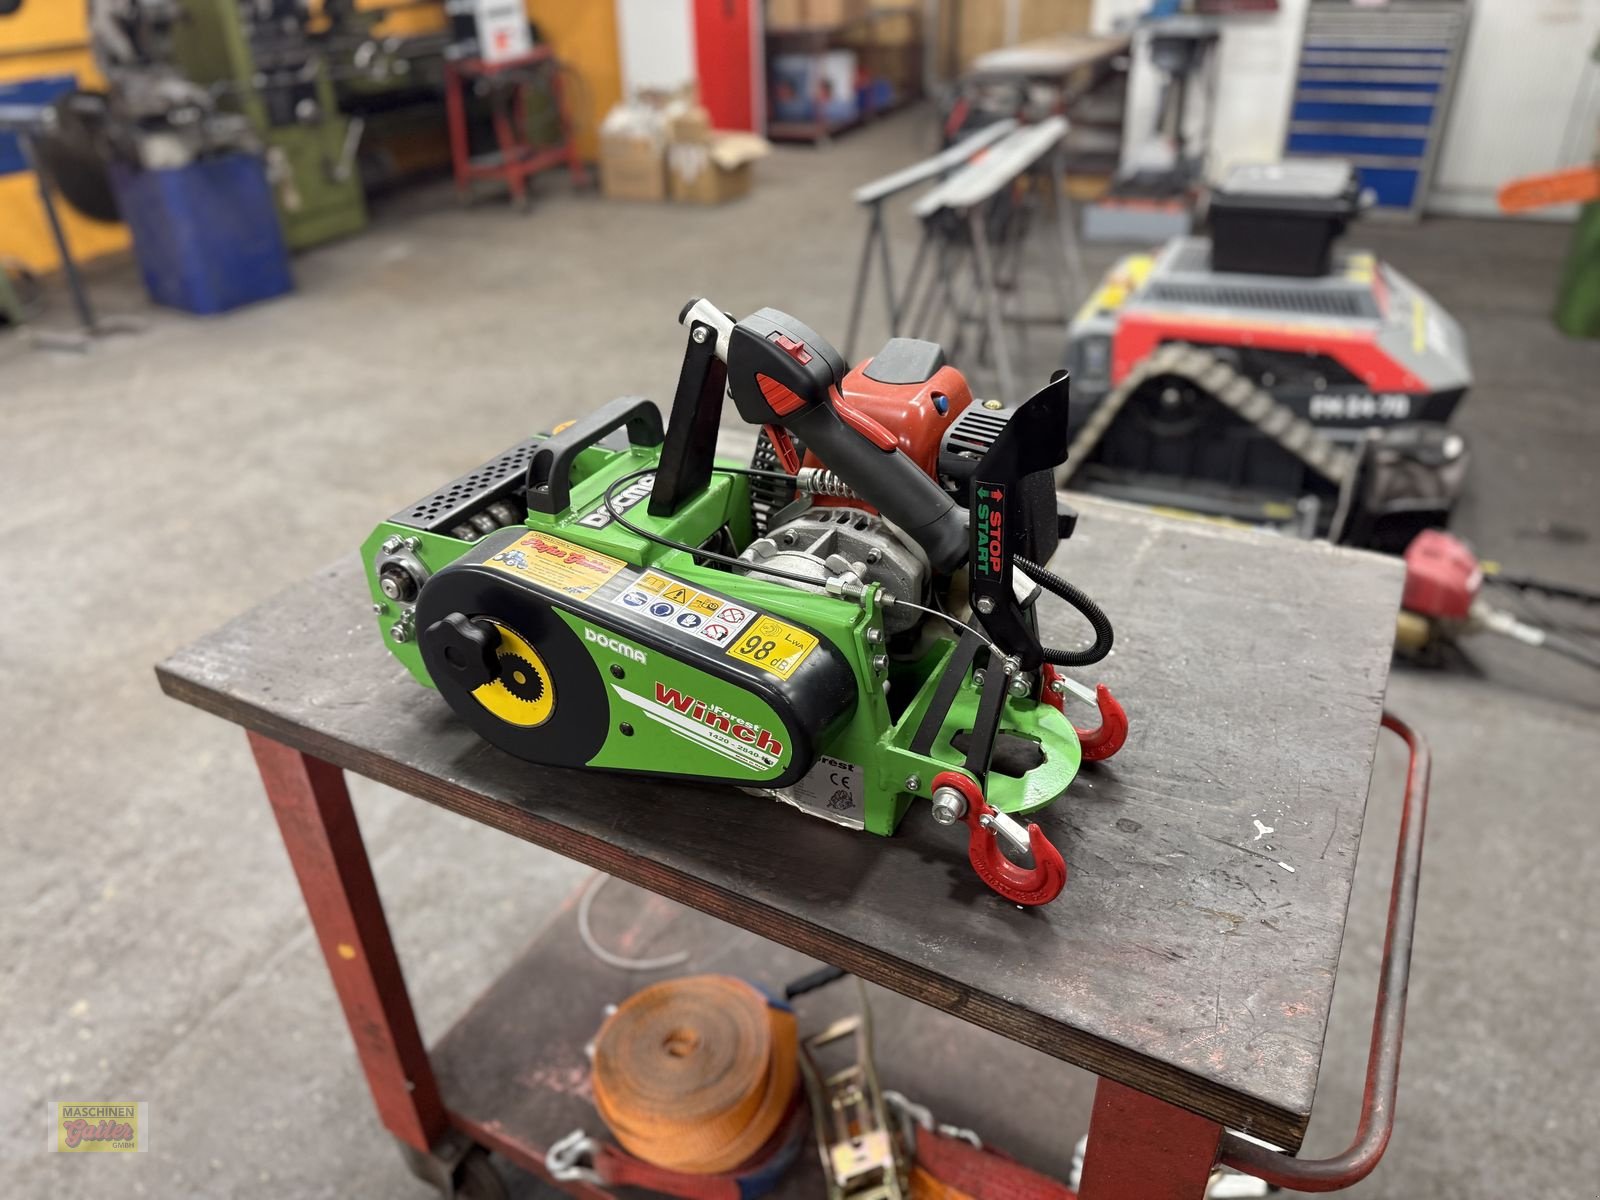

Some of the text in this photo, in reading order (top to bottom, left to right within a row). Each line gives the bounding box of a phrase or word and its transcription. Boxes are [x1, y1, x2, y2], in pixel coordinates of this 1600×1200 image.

[977, 503, 989, 576] START
[989, 511, 1002, 572] STOP
[584, 627, 646, 665] DOCMA
[740, 635, 788, 671] 98 dB
[655, 681, 783, 757] Winch
[709, 731, 729, 744] 1420
[737, 744, 759, 758] 2840
[820, 757, 854, 772] rest
